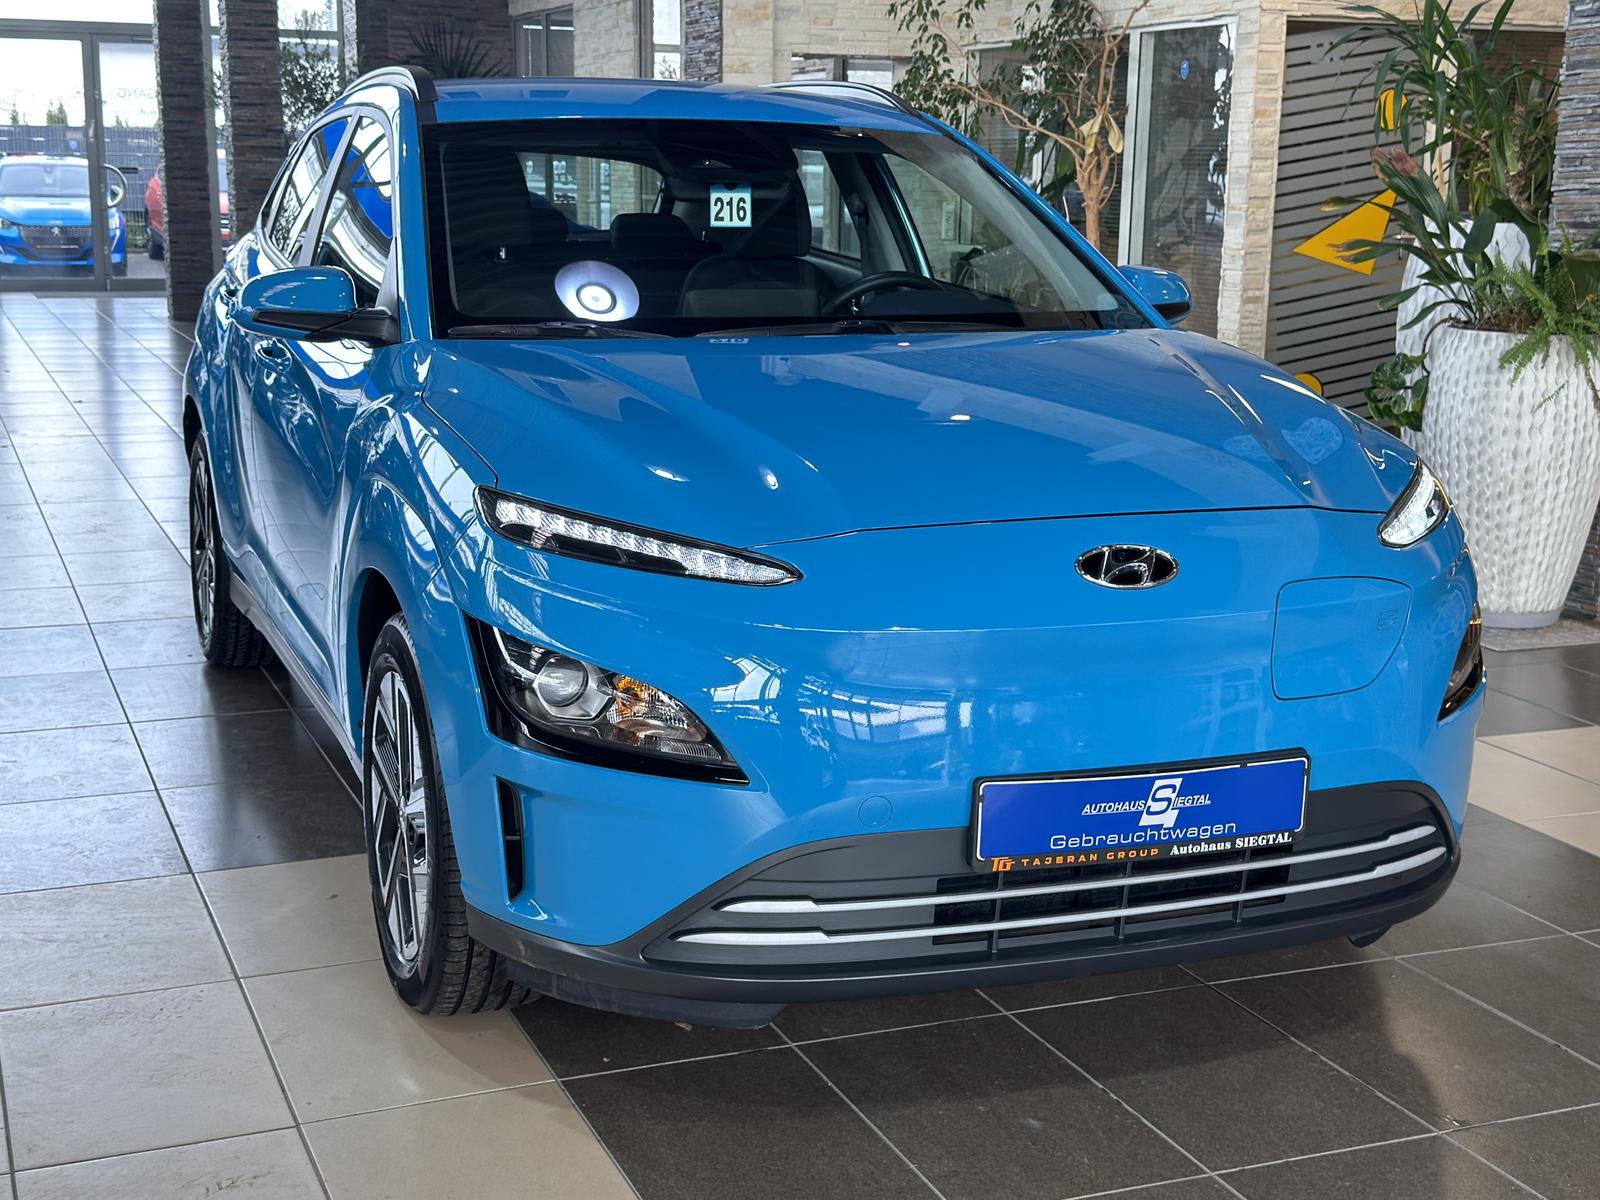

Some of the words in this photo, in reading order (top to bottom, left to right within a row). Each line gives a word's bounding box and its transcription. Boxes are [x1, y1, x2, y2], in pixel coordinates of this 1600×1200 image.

[713, 196, 747, 222] 216
[1081, 800, 1147, 815] AUTOHAUS
[1050, 822, 1236, 849] Gebrauchtwagen
[1169, 841, 1232, 856] Autohaus
[1235, 832, 1292, 848] SIEGTAL
[1021, 853, 1098, 867] TAJERAN
[1106, 848, 1159, 860] GROUP
